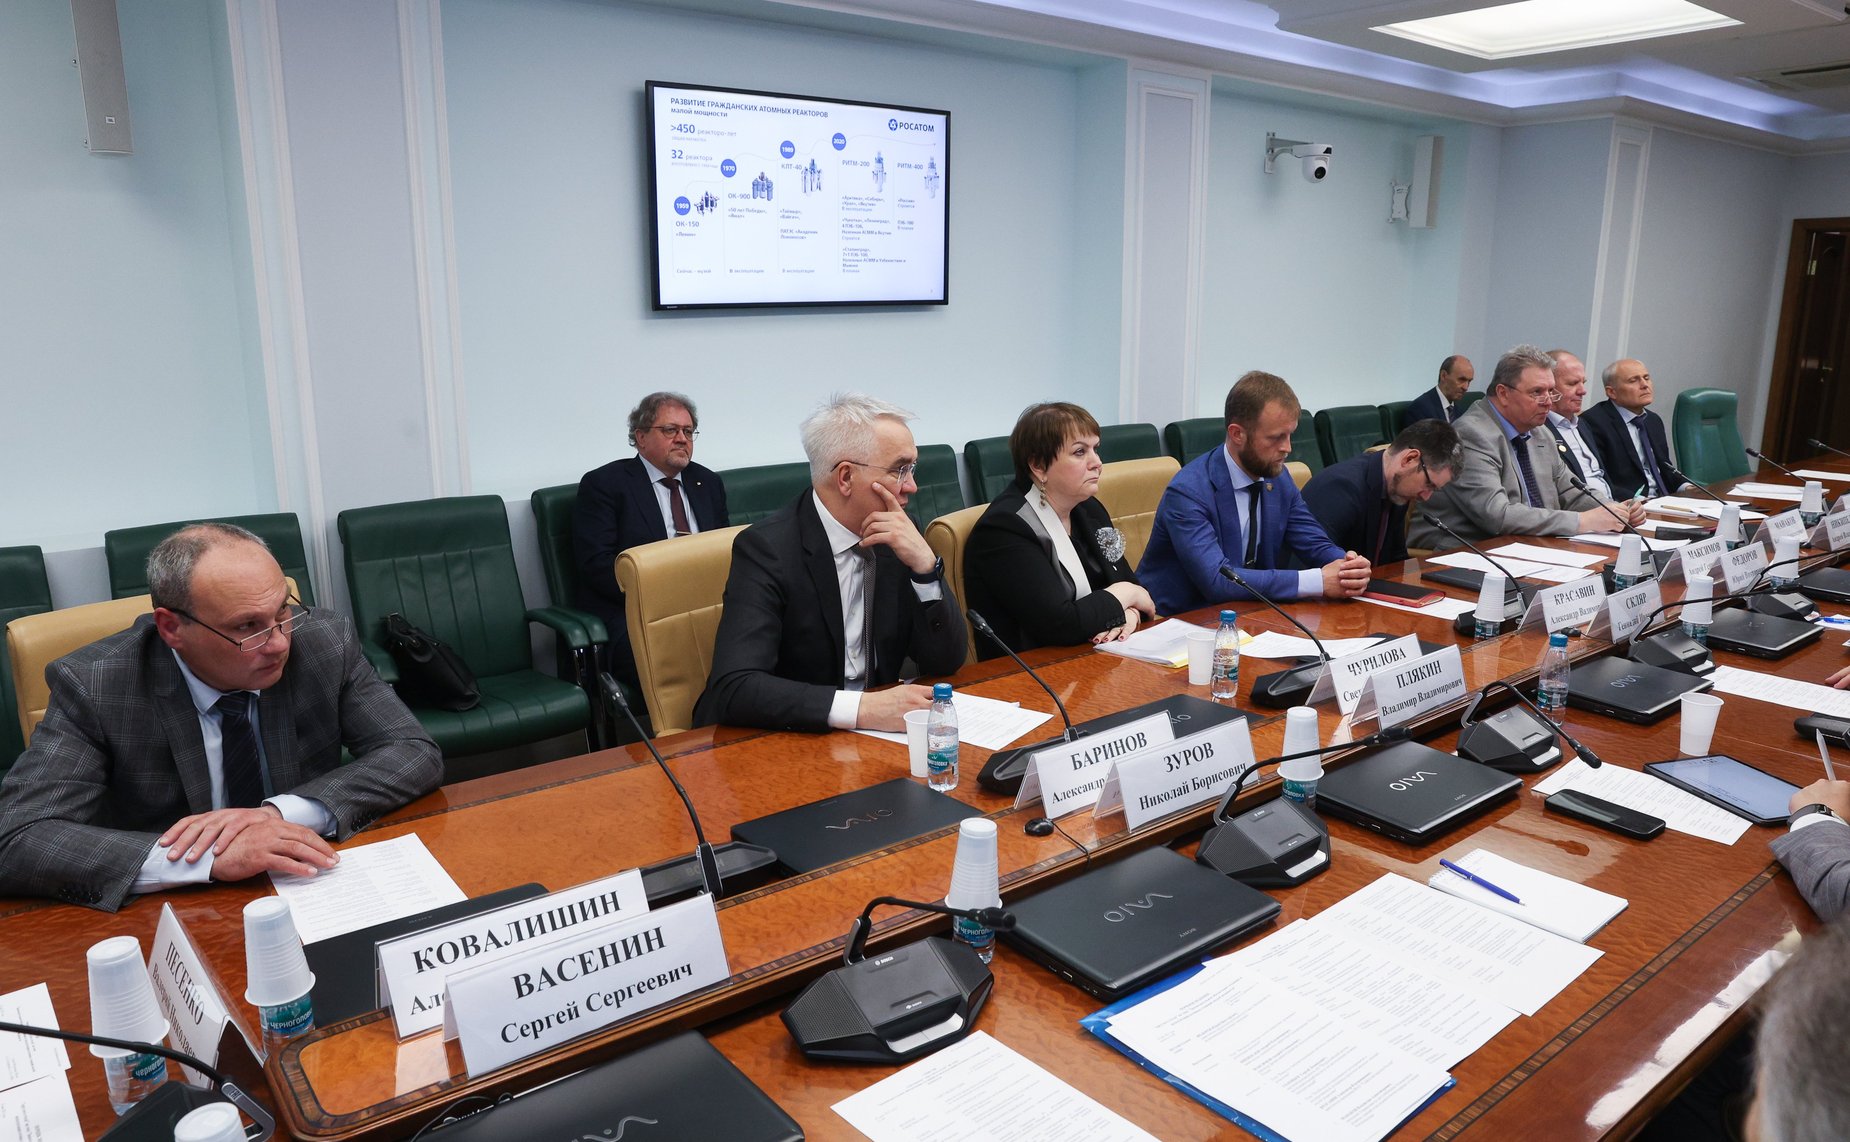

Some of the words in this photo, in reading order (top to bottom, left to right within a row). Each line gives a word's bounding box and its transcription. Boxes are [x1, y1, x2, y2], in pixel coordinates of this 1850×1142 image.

[671, 98, 706, 107] РАЗВИТИЕ
[708, 101, 758, 112] ГРАЖДАНСКИХ
[759, 105, 791, 115] АТОМНЫХ
[793, 109, 829, 118] РЕАКТОРОВ
[694, 110, 728, 118] мощности
[671, 123, 695, 134] >450
[899, 122, 934, 132] РОСАТОМ
[671, 150, 683, 159] 32
[897, 162, 923, 170] РИТМ-400
[1687, 542, 1721, 560] МАКСИМОВ
[1732, 550, 1758, 566] ФЕДОРОВ
[1554, 584, 1596, 606] КРАСАВИН
[1626, 592, 1647, 610] СКЛЯР
[1347, 647, 1406, 676] ЧУРИЛОВА
[1396, 660, 1442, 689] ПЛЯКИН
[1382, 698, 1418, 717] Владимир
[1417, 678, 1463, 702] Владимирович
[1070, 732, 1147, 771] БАРИНОВ
[1163, 742, 1214, 772] ЗУРОВ
[1052, 777, 1105, 804] Александр
[1139, 781, 1190, 810] Николай
[1191, 762, 1247, 791] Борисович
[412, 890, 622, 974] КОВАЛИШИН
[512, 926, 666, 999] ВАСЕНИН
[165, 940, 204, 1025] ПЕСЕНКО
[501, 1002, 581, 1044] Сергей
[586, 963, 694, 1013] Сергеевич
